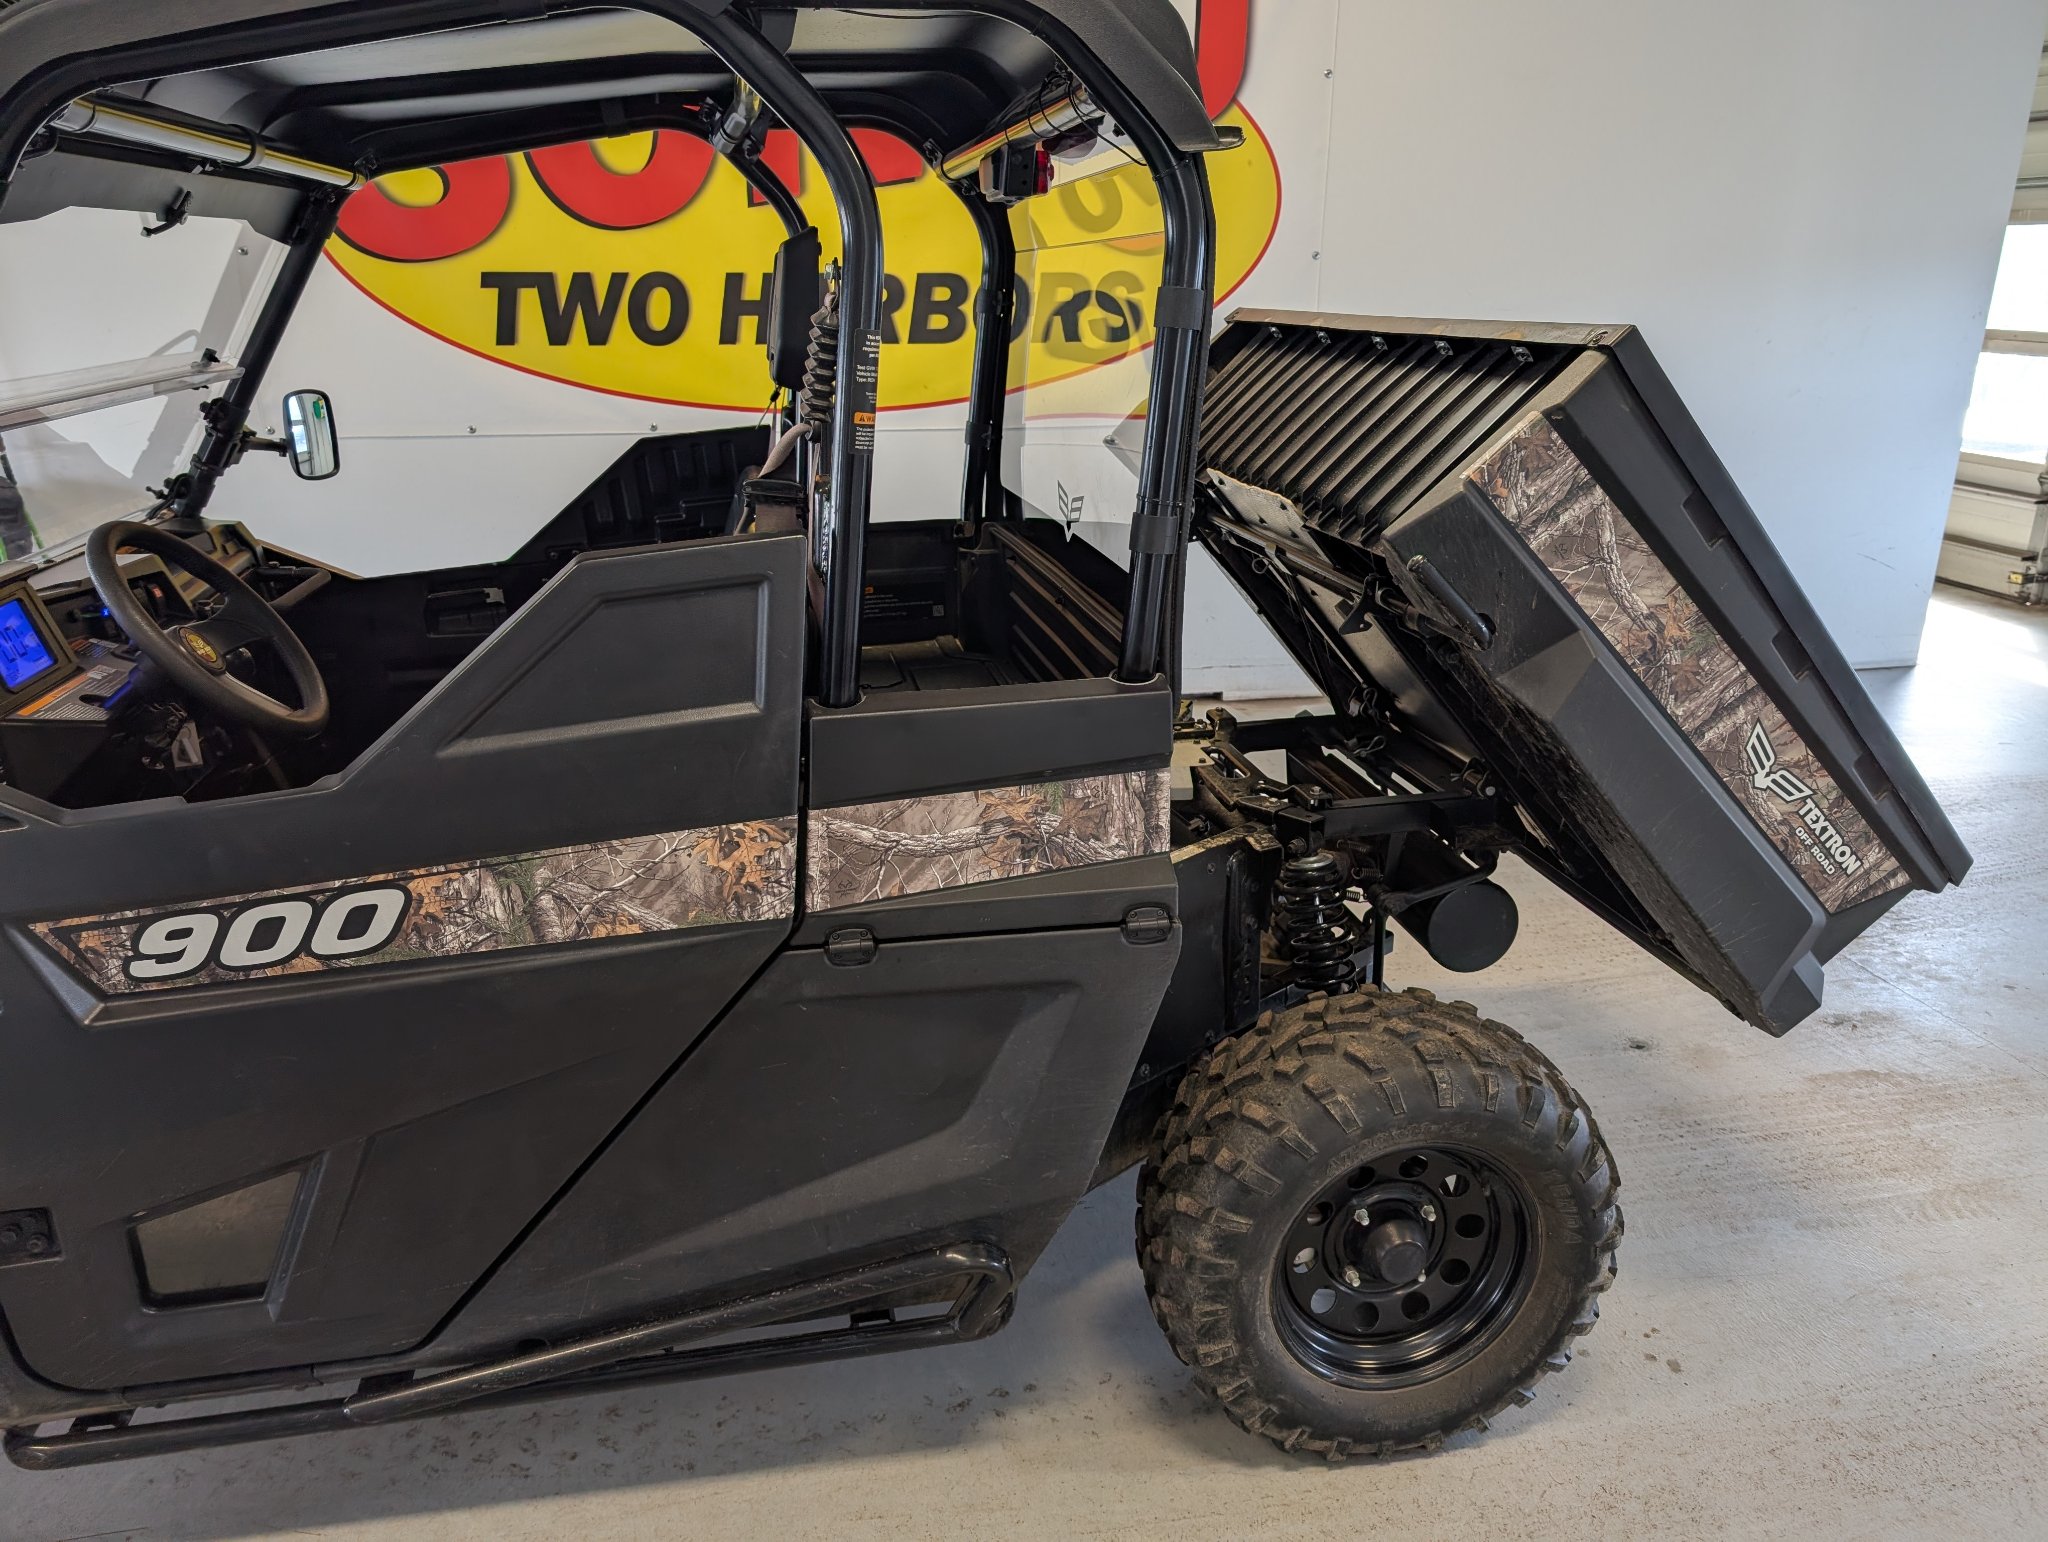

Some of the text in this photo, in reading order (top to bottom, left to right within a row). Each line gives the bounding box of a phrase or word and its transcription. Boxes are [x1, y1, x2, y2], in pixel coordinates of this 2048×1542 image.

[481, 270, 1143, 346] TWO HBORS
[1795, 826, 1836, 875] OFF ROAD
[1798, 797, 1862, 875] TEXTRON
[129, 888, 405, 978] 900
